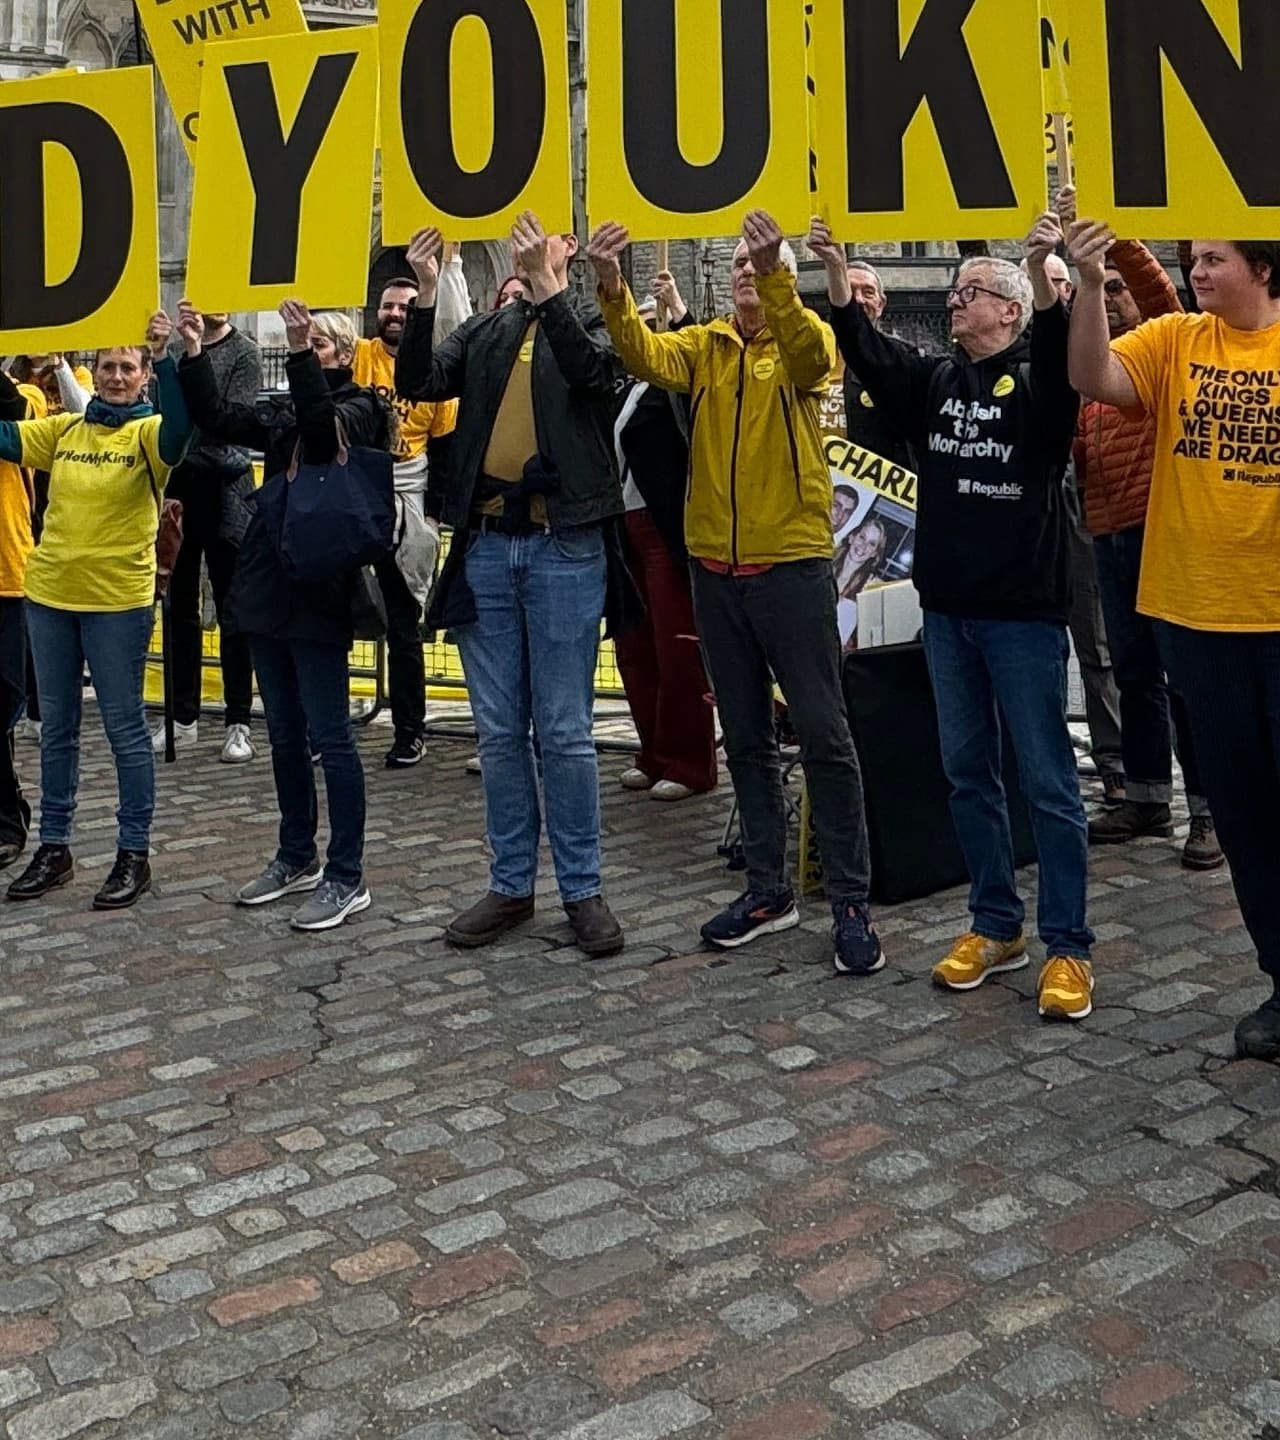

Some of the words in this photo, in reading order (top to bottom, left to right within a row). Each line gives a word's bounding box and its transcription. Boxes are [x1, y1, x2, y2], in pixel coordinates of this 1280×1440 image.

[1189, 361, 1230, 384] THE
[1196, 381, 1271, 406] KINGS
[1178, 398, 1188, 417] &
[1182, 418, 1213, 439] WE
[928, 432, 1014, 464] Monarchy
[1172, 438, 1213, 460] ARE
[972, 480, 1024, 497] Republic
